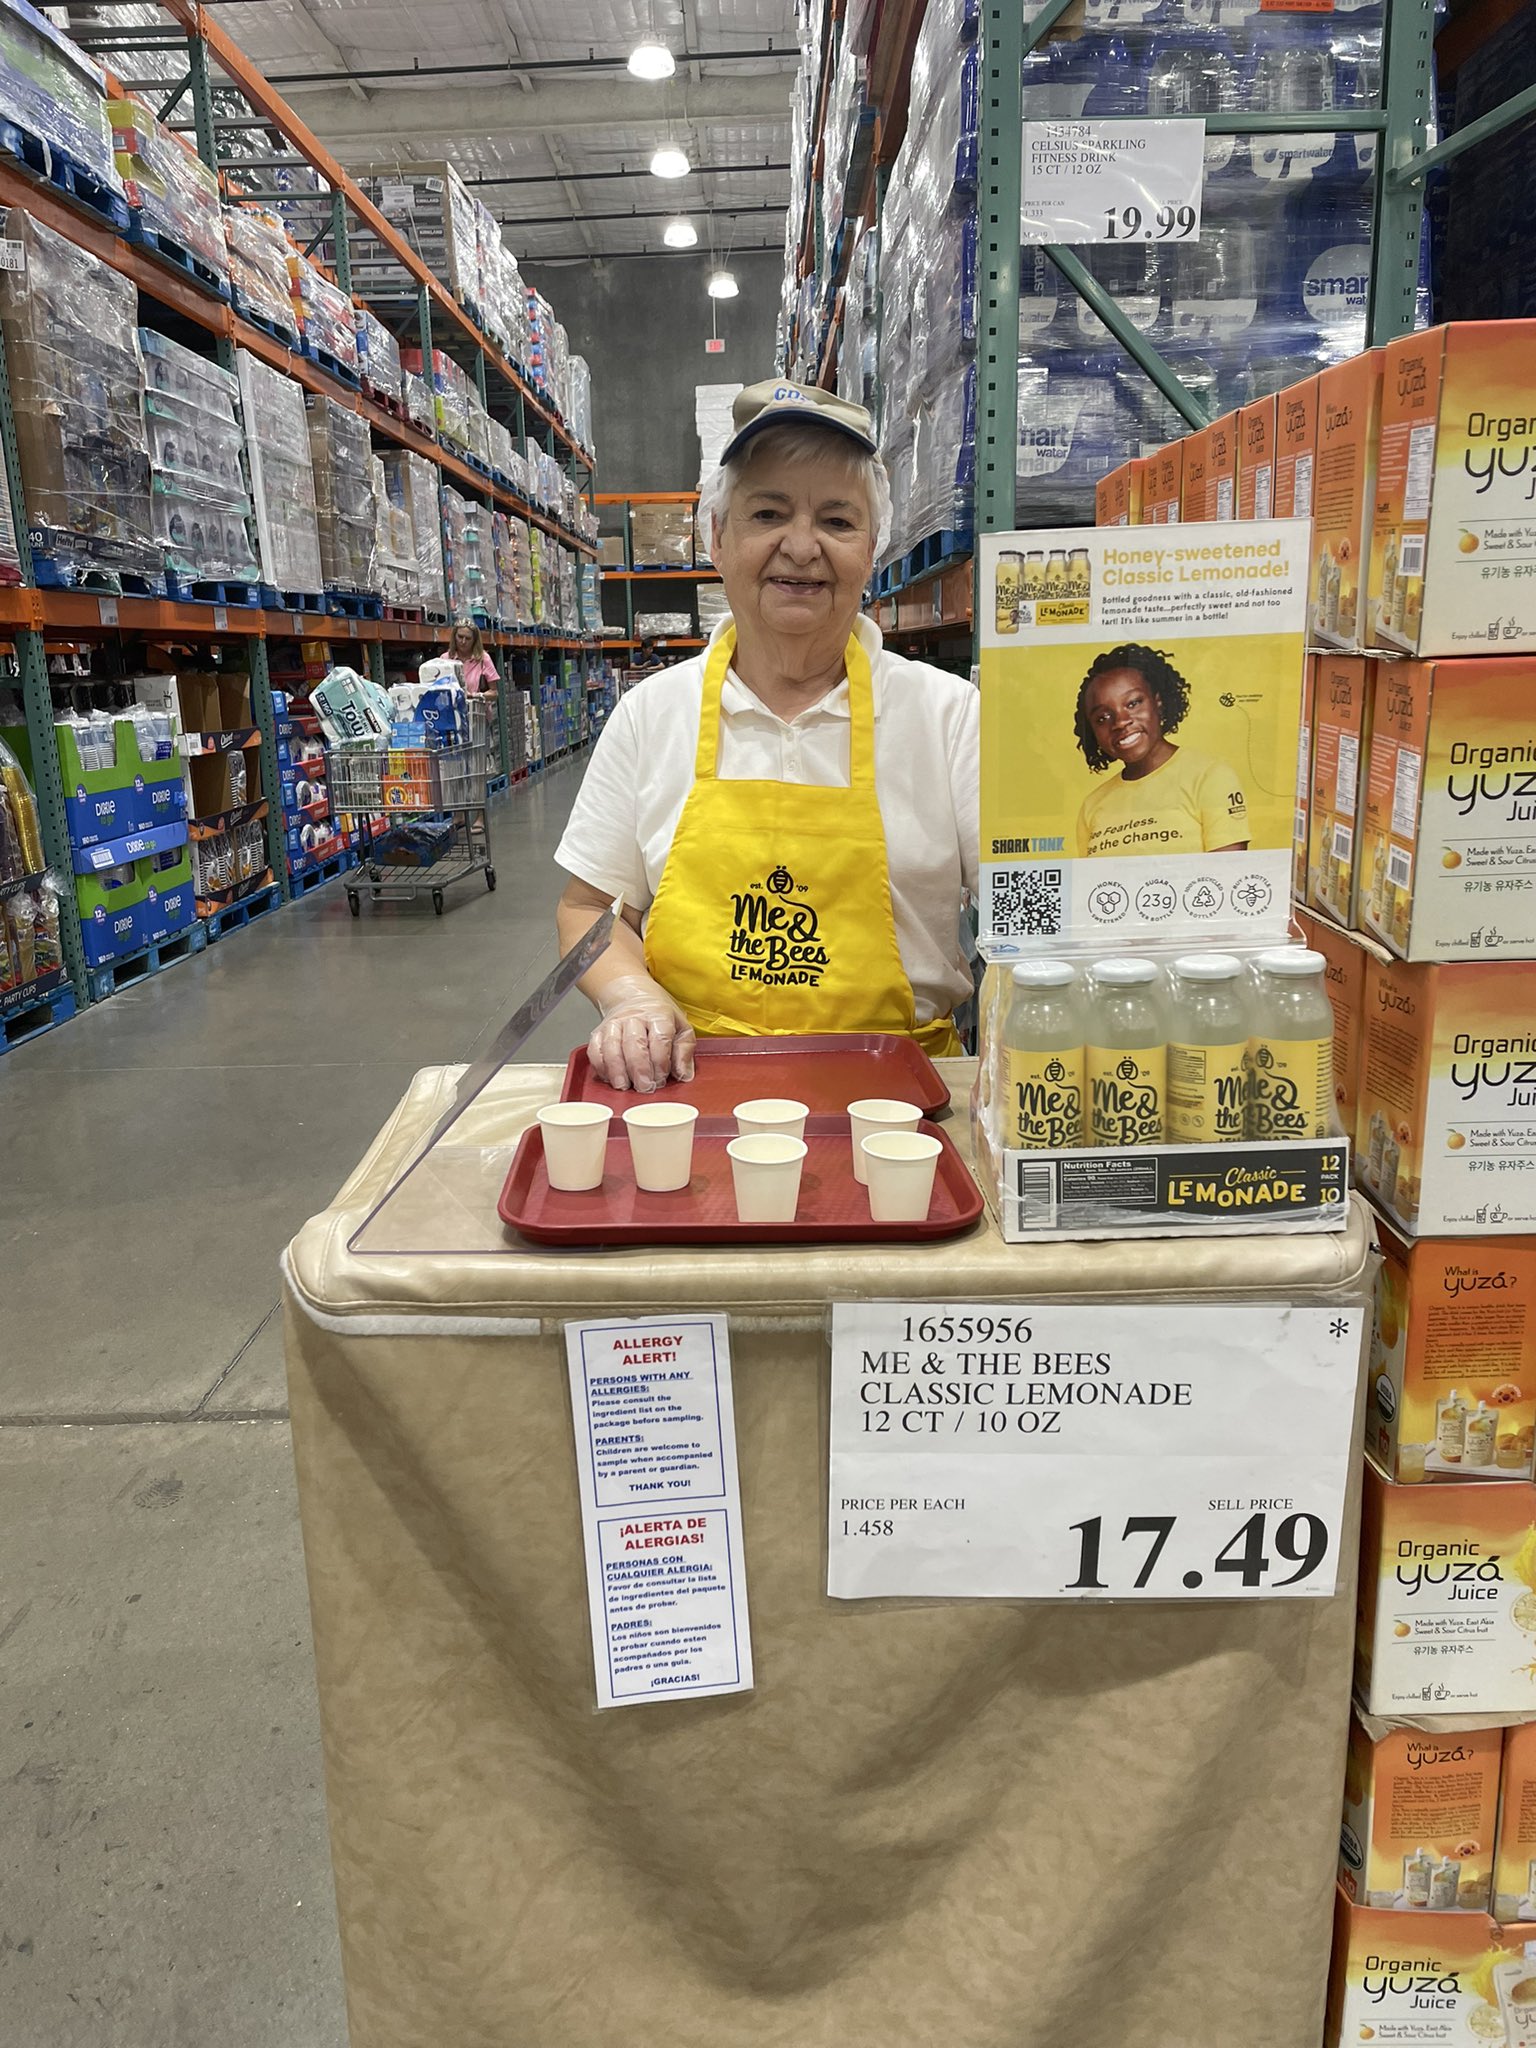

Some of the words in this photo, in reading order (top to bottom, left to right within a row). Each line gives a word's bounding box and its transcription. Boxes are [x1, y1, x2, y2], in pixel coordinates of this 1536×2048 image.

[1031, 141, 1078, 151] CELSIUS
[1082, 139, 1146, 150] SPARKLING
[1032, 153, 1077, 163] FITNESS
[1080, 153, 1117, 162] DRINK
[1032, 165, 1043, 175] 15
[1045, 165, 1061, 174] CT
[1072, 164, 1083, 174] 12
[1086, 164, 1102, 174] OZ
[1103, 205, 1196, 240] 19.99
[1103, 539, 1281, 567] Honey-sweetened
[1103, 568, 1174, 586] Classic
[1179, 560, 1289, 582] Lemonade!
[1102, 595, 1130, 604] Bottled
[1133, 594, 1171, 605] goodness
[1174, 592, 1192, 600] with
[1202, 590, 1233, 599] classic,
[1236, 587, 1293, 597] old-fashioned
[1040, 607, 1085, 617] LEMONADE
[1102, 606, 1142, 615] lemonade
[1208, 601, 1232, 609] sweet
[1235, 600, 1250, 608] and
[1267, 599, 1281, 607] too
[1135, 615, 1150, 624] like
[1202, 612, 1229, 620] bottle!
[1227, 791, 1244, 806] 10
[1103, 817, 1158, 836] Fearless.
[992, 838, 1030, 854] SHARK
[1031, 837, 1065, 852] TANK
[1100, 839, 1119, 851] the
[1122, 829, 1183, 844] Change.
[1097, 881, 1122, 889] HONEY
[1145, 879, 1169, 887] SUGAR
[1197, 876, 1224, 892] RECYCLED
[1232, 879, 1243, 890] BUY
[1250, 874, 1271, 888] BOTTLE
[1464, 880, 1493, 893] 유기농
[1142, 893, 1172, 909] 23g
[730, 893, 790, 933] Me
[1138, 911, 1149, 920] PER
[1150, 910, 1174, 922] BOTTLE
[1189, 910, 1217, 919] BOTTLES
[730, 928, 766, 956] the
[764, 935, 830, 971] Bees
[730, 964, 820, 987] LEMONADE
[1090, 1078, 1137, 1113] Me
[1091, 1107, 1118, 1133] the
[1117, 1115, 1164, 1146] Bees
[1063, 1162, 1104, 1170] Nutrition
[1106, 1161, 1132, 1169] Facts
[1321, 1155, 1341, 1172] 12
[1224, 1166, 1278, 1187] Classic
[1321, 1173, 1339, 1181] PACK
[1168, 1180, 1307, 1208] LEMONADE
[1320, 1187, 1341, 1204] 10
[1445, 1266, 1471, 1276] What
[901, 1317, 1033, 1344] 1655956
[613, 1335, 683, 1351] ALLERGY
[622, 1352, 677, 1366] ALERT!
[860, 1351, 911, 1376] ME
[920, 1352, 946, 1376] &
[957, 1352, 1022, 1375] THE
[1032, 1352, 1111, 1376] BEES
[590, 1375, 637, 1385] PERSONS
[640, 1373, 668, 1382] WITH
[669, 1371, 691, 1380] ANY
[590, 1385, 650, 1396] ALLERGIES:
[860, 1382, 996, 1406] CLASSIC
[1005, 1382, 1193, 1406] LEMONADE
[592, 1398, 621, 1407] Please
[623, 1395, 655, 1405] consult
[657, 1394, 672, 1402] the
[592, 1408, 637, 1419] ingredient
[638, 1406, 653, 1414] list
[593, 1420, 631, 1430] package
[632, 1417, 660, 1426] before
[662, 1413, 704, 1425] sampling.
[861, 1411, 891, 1433] 12
[902, 1411, 945, 1434] CT
[977, 1411, 1008, 1433] 10
[1017, 1410, 1062, 1433] OZ
[595, 1434, 645, 1446] PARENTS:
[596, 1447, 632, 1457] Children
[650, 1443, 690, 1452] welcome
[597, 1458, 628, 1468] sample
[630, 1456, 654, 1464] when
[656, 1451, 713, 1463] accompanied
[598, 1470, 609, 1478] by
[618, 1466, 647, 1477] parent
[660, 1463, 700, 1474] guardian.
[629, 1481, 664, 1492] THANK
[667, 1479, 692, 1489] YOU!
[841, 1498, 887, 1511] PRICE
[890, 1498, 920, 1510] PER
[923, 1498, 966, 1510] EACH
[1208, 1499, 1246, 1511] SELL
[1249, 1498, 1294, 1510] PRICE
[620, 1520, 683, 1538] ¡ALERTA
[687, 1517, 707, 1528] DE
[841, 1519, 895, 1537] 1.458
[624, 1533, 704, 1551] ALERGIAS!
[1397, 1538, 1480, 1561] Organic
[1064, 1512, 1329, 1590] 17.49
[606, 1557, 660, 1570] PERSONAS
[662, 1556, 684, 1565] CON
[606, 1568, 665, 1581] CUALQUIER
[667, 1563, 713, 1574] ALERGIA:
[1447, 1584, 1499, 1601] Juice
[611, 1619, 653, 1632] PADRES:
[650, 1673, 701, 1688] ¡GRACIAS!
[1365, 1956, 1442, 1974] Organic
[1410, 1994, 1456, 2009] Juice
